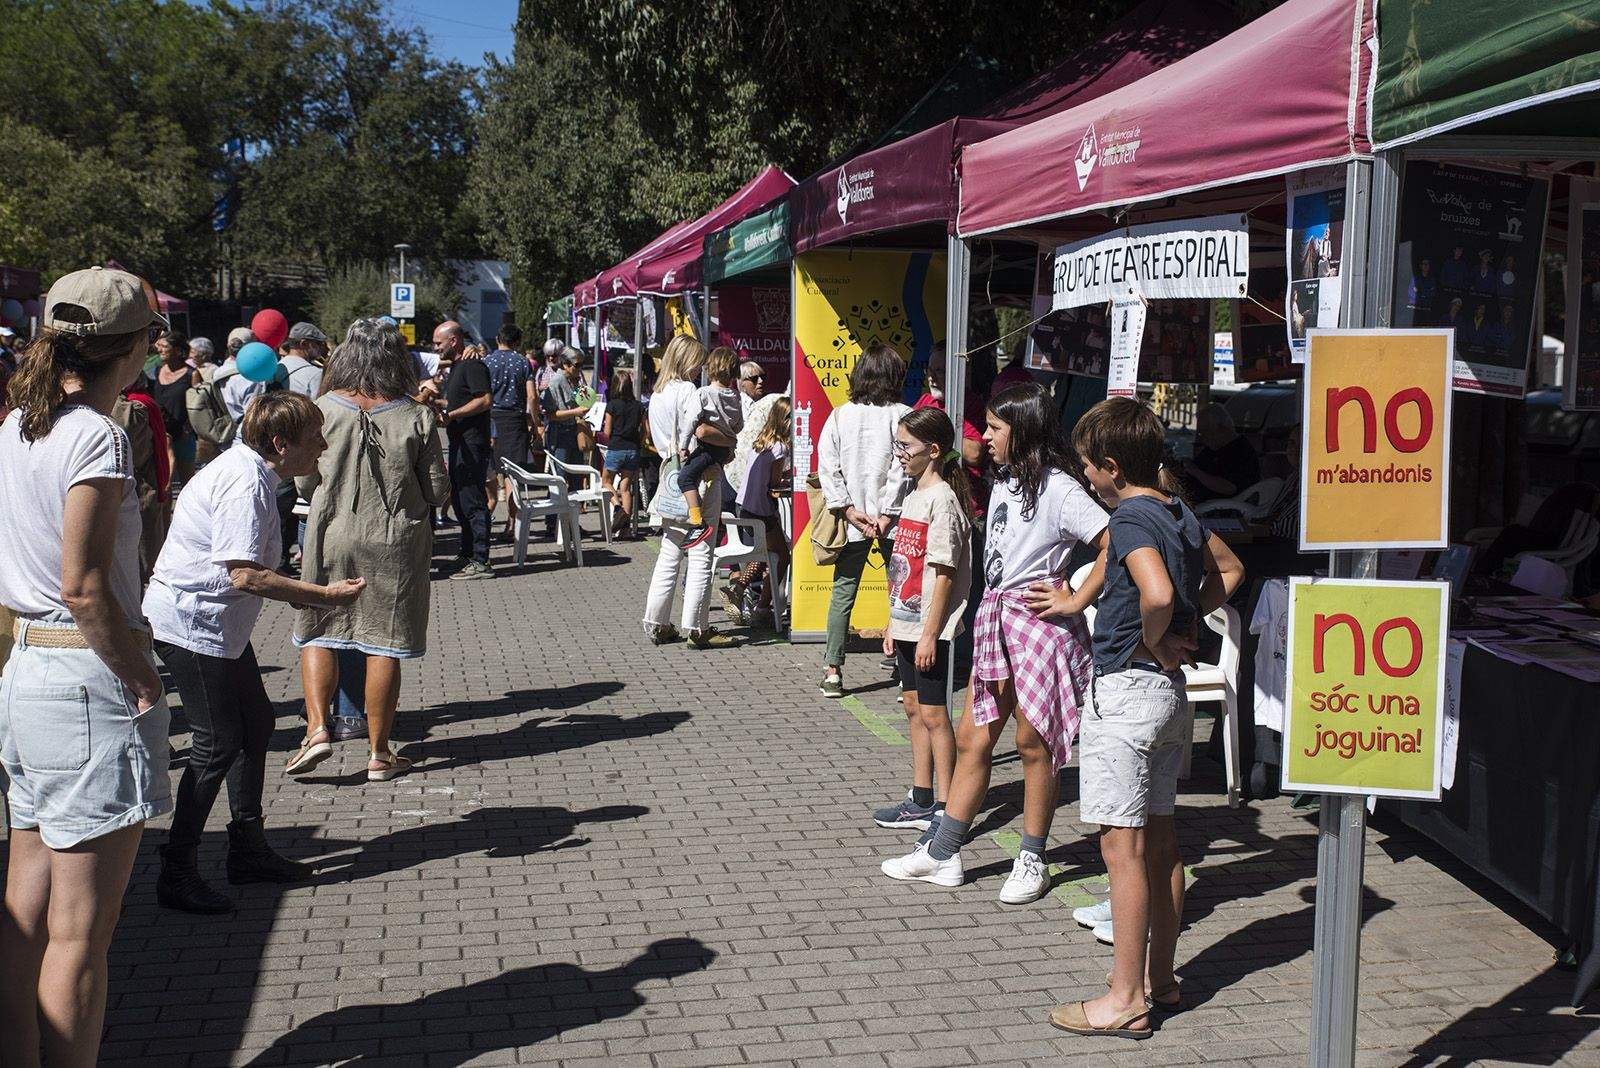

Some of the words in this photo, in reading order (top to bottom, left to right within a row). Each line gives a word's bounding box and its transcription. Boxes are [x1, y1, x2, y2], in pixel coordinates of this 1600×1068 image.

[1478, 199, 1493, 211] de
[1440, 211, 1481, 226] bruixes
[1163, 235, 1247, 280] ESPIRAL
[398, 288, 408, 300] P
[807, 286, 840, 296] Cultural
[804, 354, 847, 369] Coral
[821, 373, 839, 387] de
[1326, 386, 1433, 453] no
[1317, 463, 1432, 484] m'abandonis
[1313, 613, 1422, 677] no
[1310, 684, 1359, 713] sóc
[1368, 693, 1420, 715] una
[1304, 724, 1422, 758] joguina!
